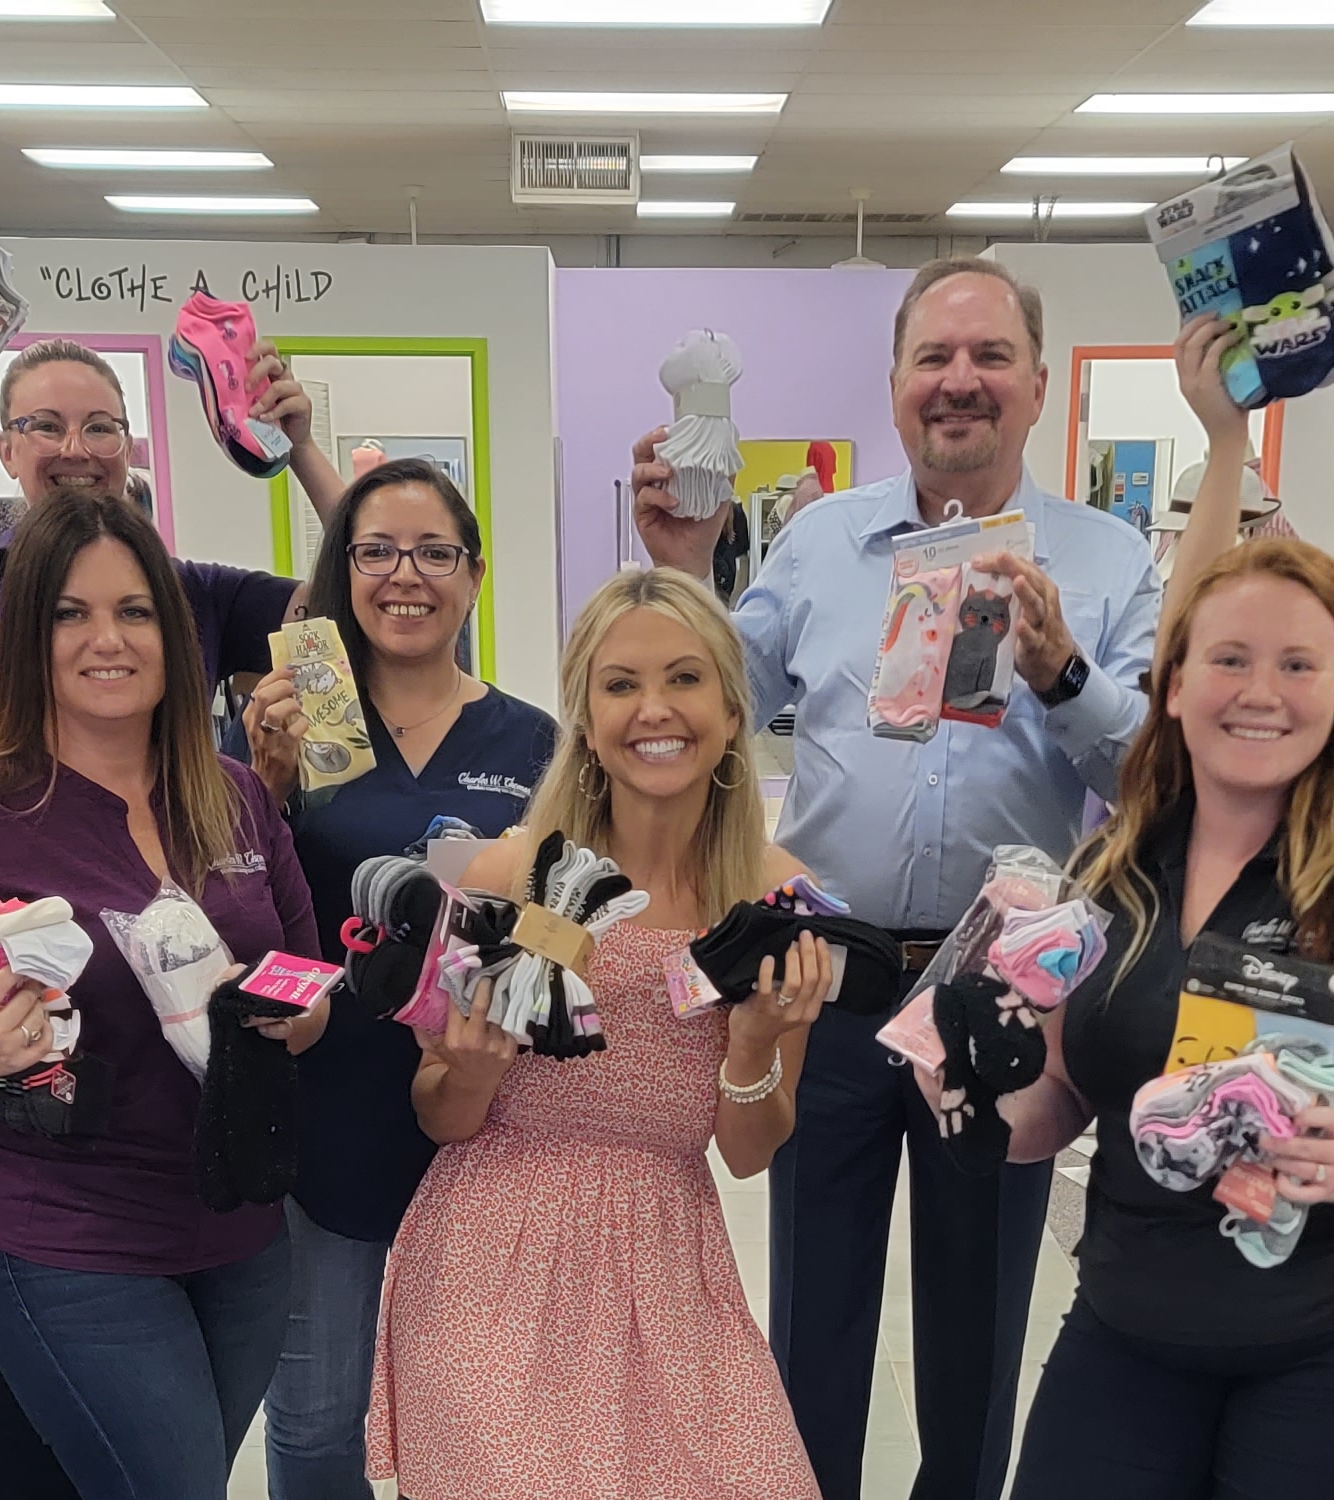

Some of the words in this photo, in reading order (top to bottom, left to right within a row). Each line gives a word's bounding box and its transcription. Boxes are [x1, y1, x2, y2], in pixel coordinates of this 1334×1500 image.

[40, 266, 172, 304] "CLOTHE
[1180, 275, 1238, 315] ATTACK
[1254, 325, 1331, 360] WARS
[922, 546, 937, 559] 10
[298, 630, 321, 644] SOCK
[308, 690, 351, 729] WESOME
[1242, 953, 1300, 993] Disney
